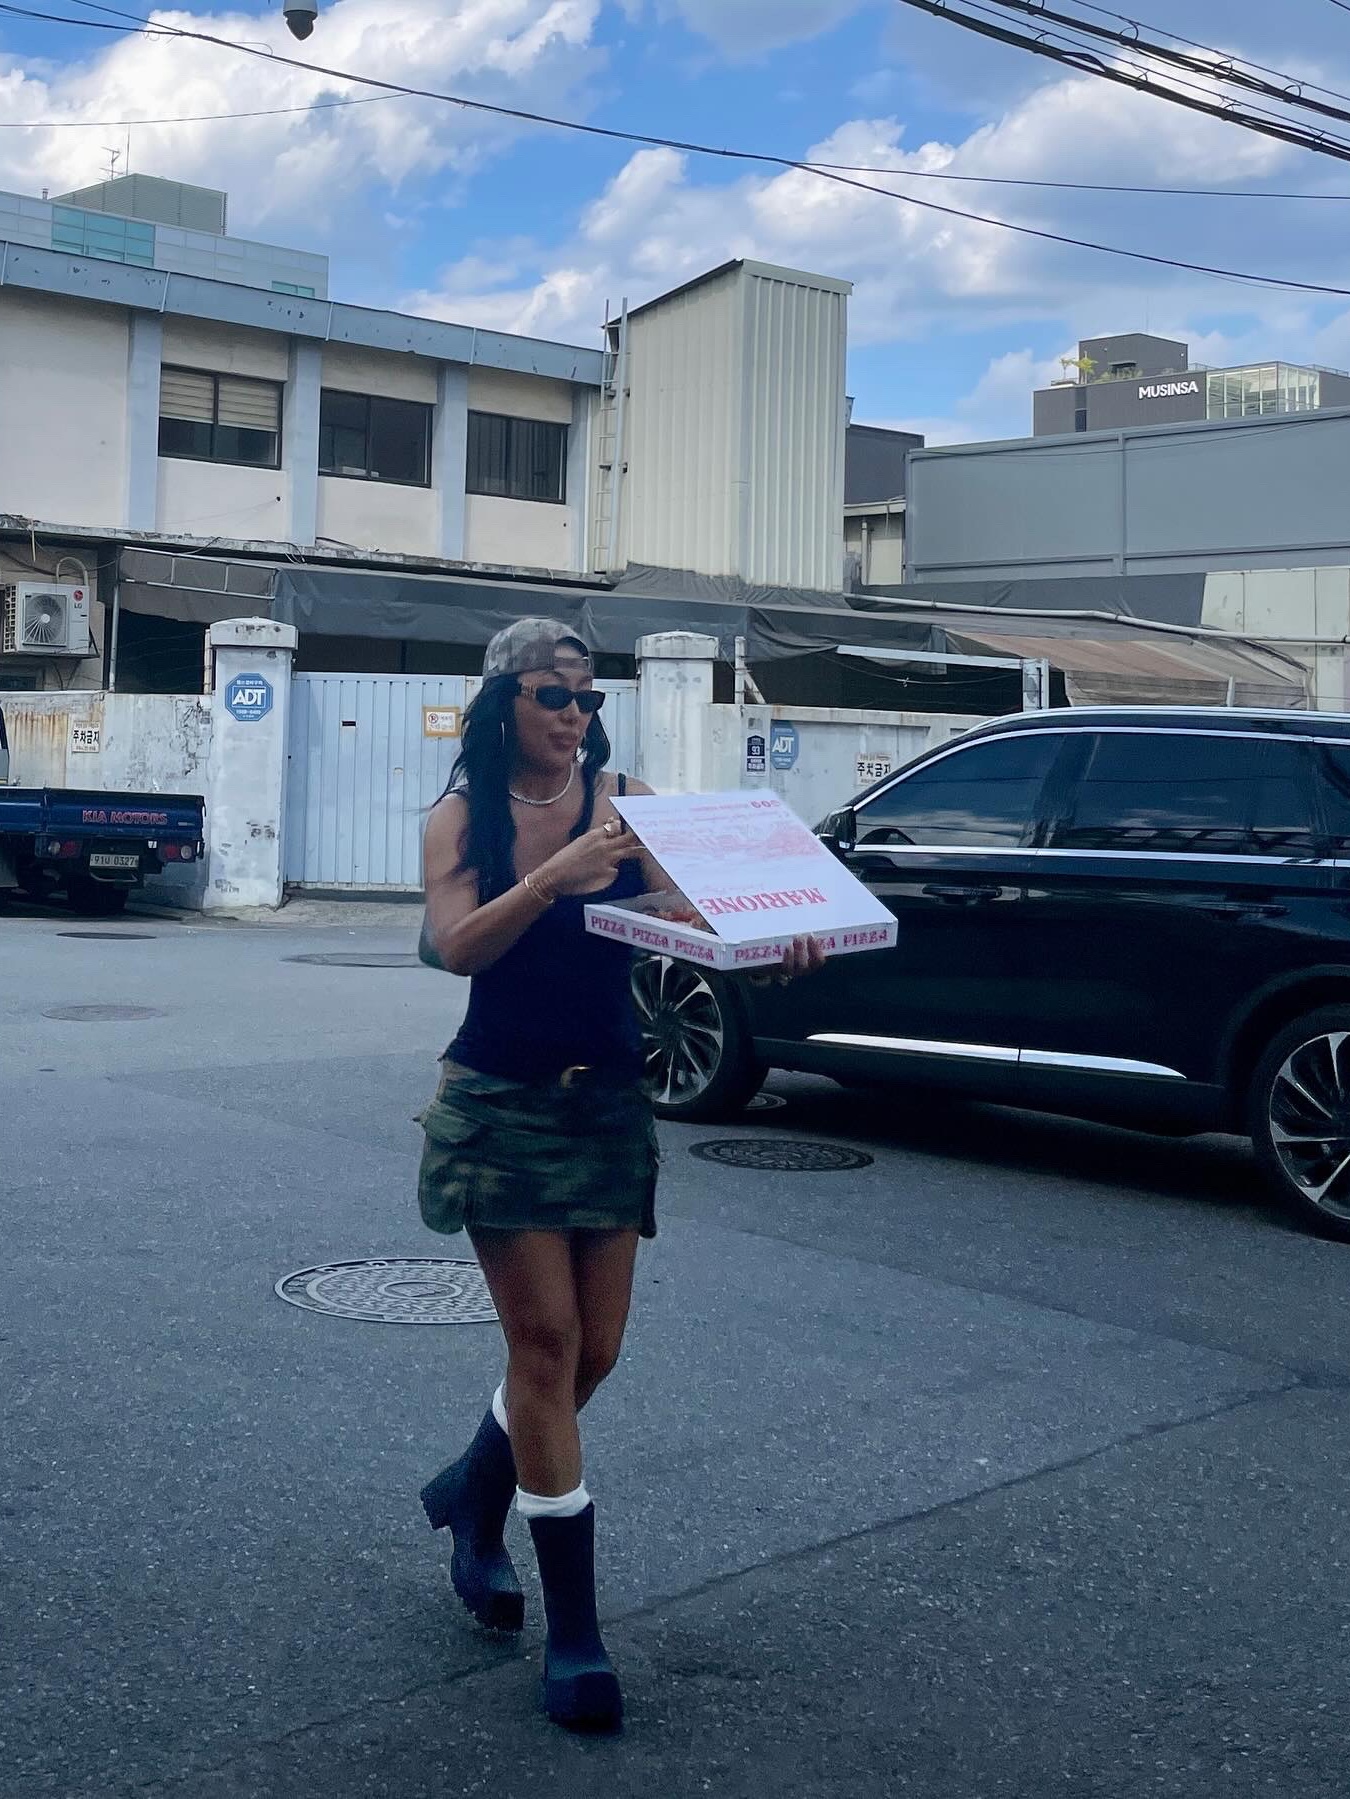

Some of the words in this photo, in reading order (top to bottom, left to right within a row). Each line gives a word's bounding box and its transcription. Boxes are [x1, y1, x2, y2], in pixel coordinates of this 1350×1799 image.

[1139, 381, 1198, 399] MUSINSA
[232, 689, 265, 705] ADT
[73, 730, 99, 744] 주차금지
[772, 737, 794, 753] ADT
[83, 810, 107, 823] KIA
[110, 811, 167, 825] MOTORS
[698, 887, 828, 915] MARIONE
[591, 916, 627, 937] PIZZA
[632, 927, 669, 948] PIZZA
[675, 939, 715, 961] PIZZA
[735, 944, 782, 963] PIZZA
[843, 929, 889, 946] PIZZA
